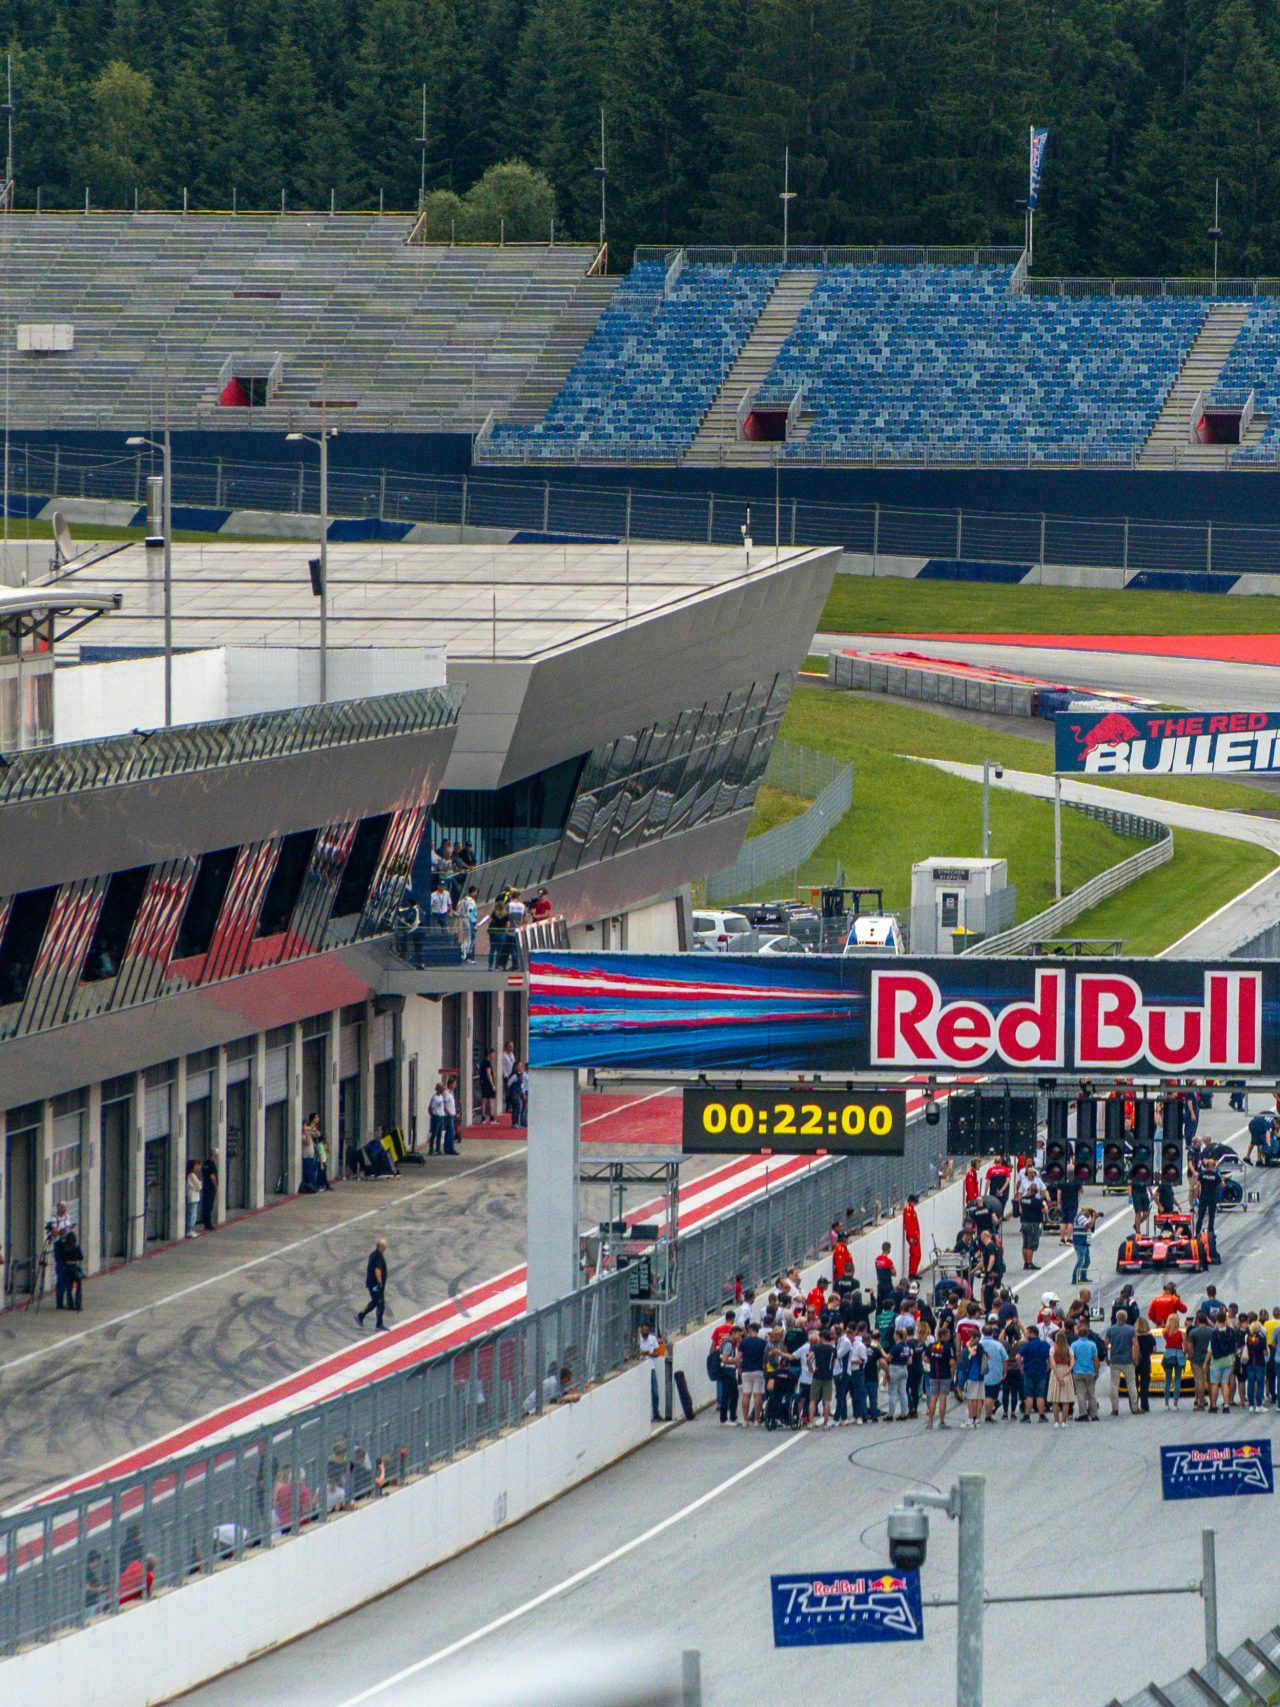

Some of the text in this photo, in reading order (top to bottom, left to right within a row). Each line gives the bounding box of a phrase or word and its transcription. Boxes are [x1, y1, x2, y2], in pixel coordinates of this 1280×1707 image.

[1147, 713, 1268, 738] THE RED
[870, 968, 1263, 1070] Red Bull
[702, 1103, 893, 1136] 00:22:00
[1191, 1447, 1231, 1461] Red Bull
[813, 1578, 866, 1596] Red Bull
